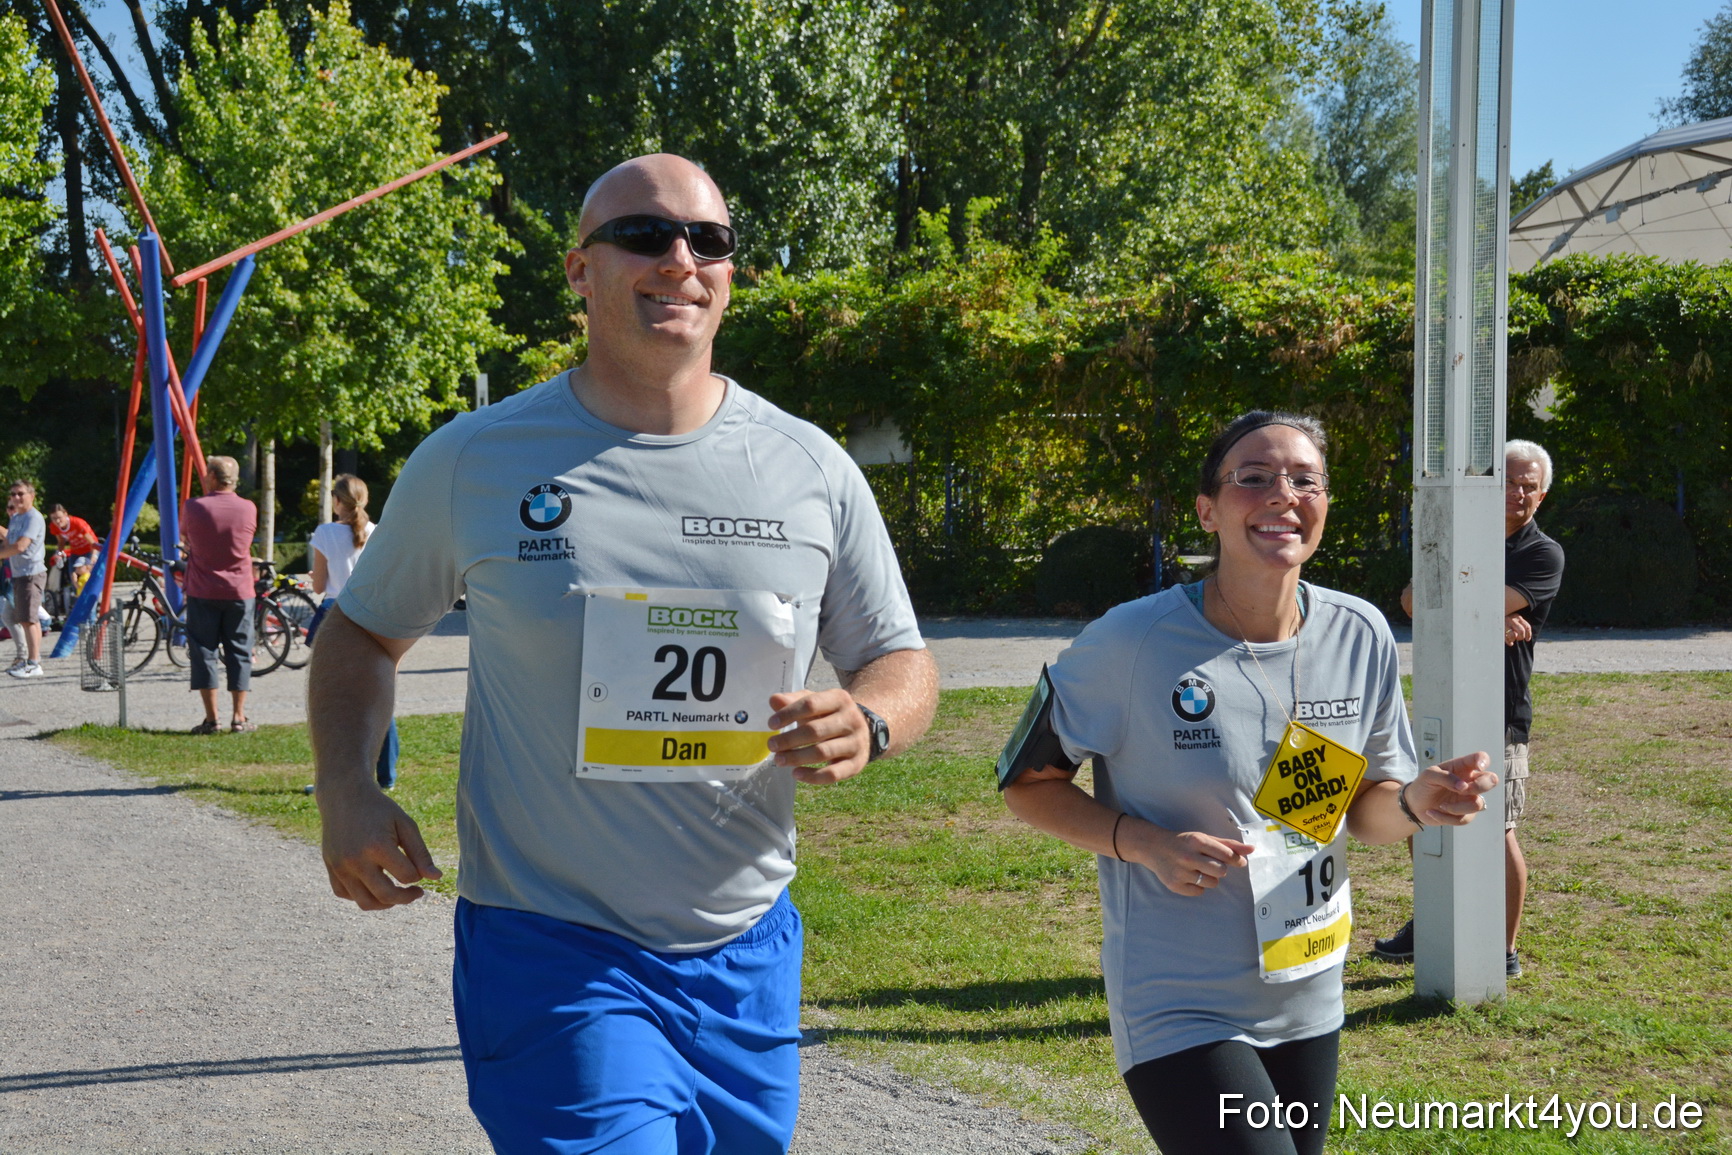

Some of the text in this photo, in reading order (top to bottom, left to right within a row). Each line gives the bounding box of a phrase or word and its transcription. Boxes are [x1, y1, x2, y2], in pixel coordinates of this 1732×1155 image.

[525, 485, 569, 503] BMW
[682, 516, 788, 542] BOCK
[519, 538, 575, 552] PARTL
[682, 537, 716, 545] inspired
[757, 541, 791, 550] concepts
[518, 550, 576, 562] Neumarkt
[648, 606, 738, 630] BOCK
[708, 630, 739, 638] concepts
[652, 644, 726, 702] 20
[593, 687, 602, 698] D
[1175, 679, 1211, 694] BMW
[626, 710, 729, 722] PARTL Neumarkt
[1293, 697, 1360, 720] BOCK
[1319, 720, 1327, 728] by
[1173, 728, 1221, 741] PARTL
[661, 737, 707, 761] Dan
[1174, 740, 1221, 750] Neumarkt
[1277, 744, 1326, 779] BABY
[1293, 765, 1323, 790] ON
[1277, 774, 1349, 816] BOARD!
[1302, 812, 1327, 826] Safety
[1298, 855, 1335, 907] 19
[1284, 916, 1311, 929] PARTL
[1304, 932, 1335, 958] Jenny
